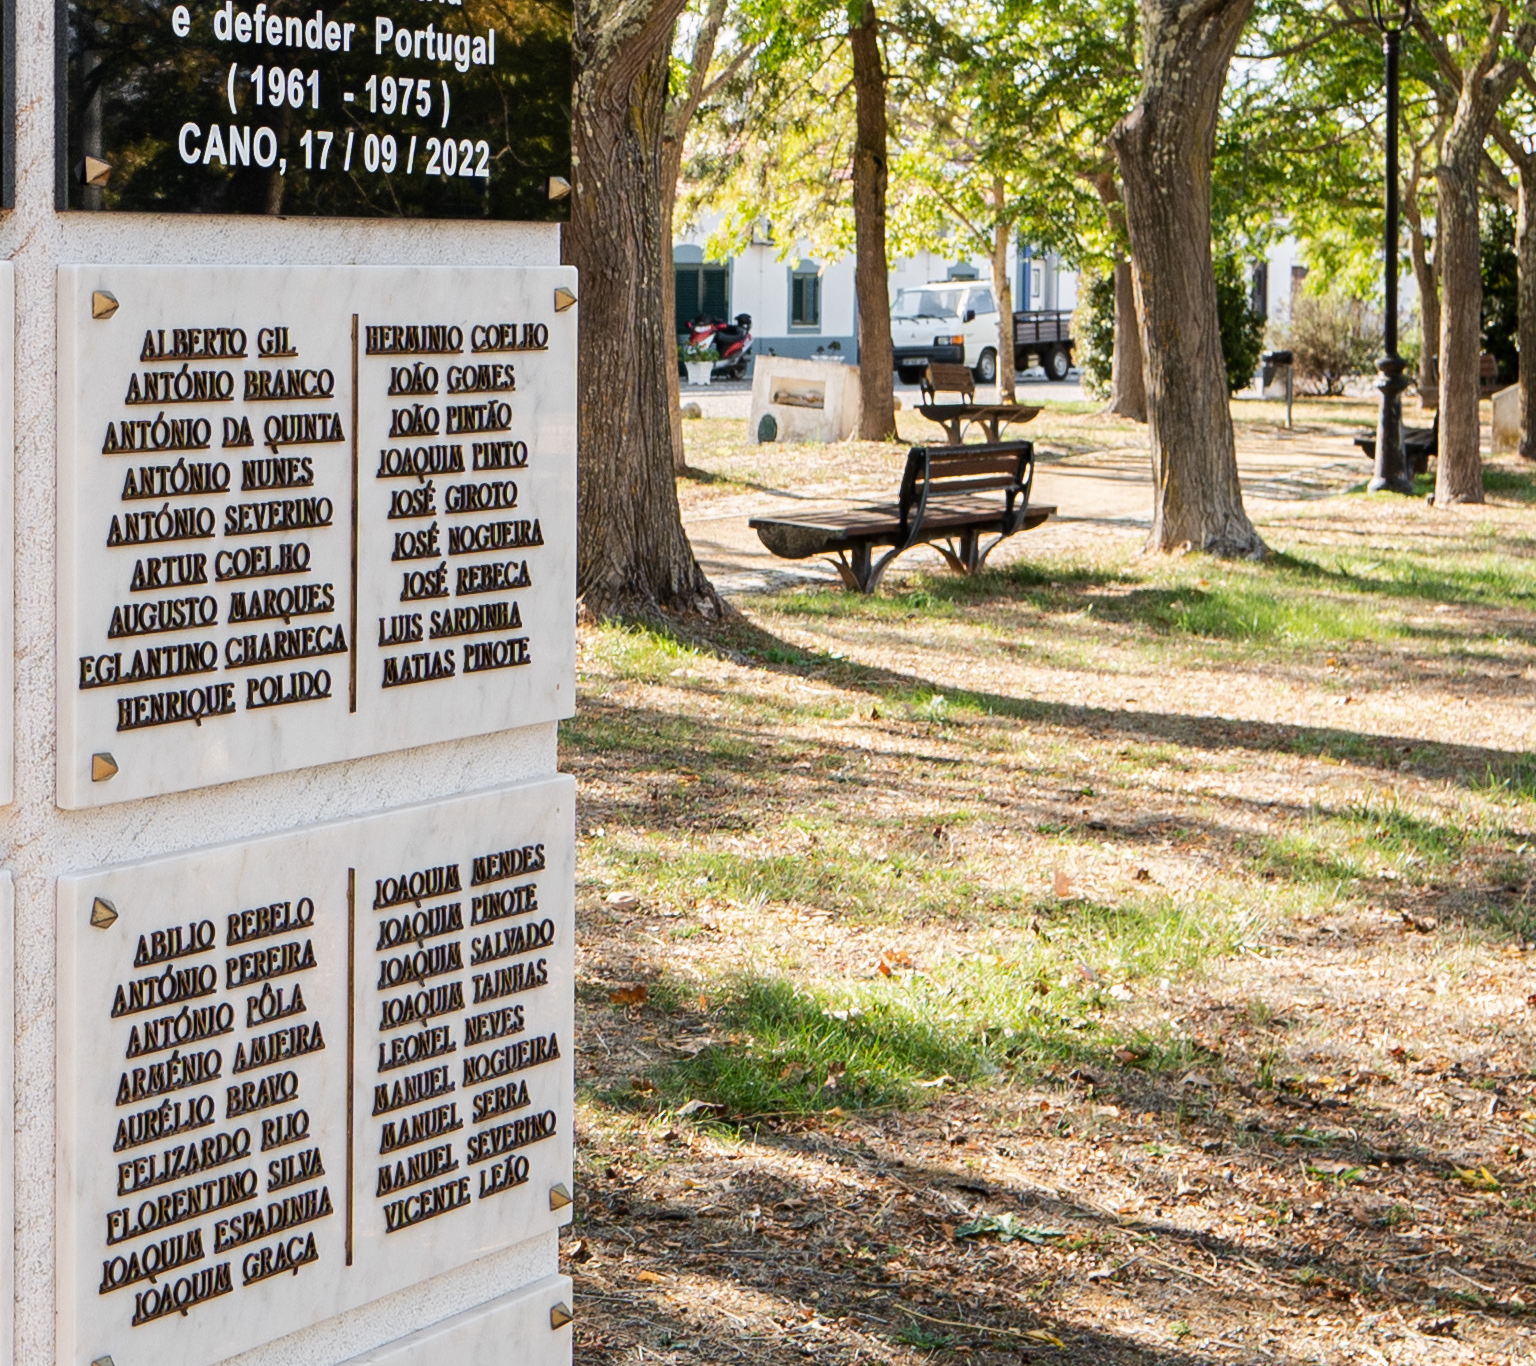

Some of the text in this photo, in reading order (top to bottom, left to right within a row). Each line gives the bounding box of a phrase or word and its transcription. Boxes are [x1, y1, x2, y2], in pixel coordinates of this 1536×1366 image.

[172, 1, 494, 72] e defender Portugal
[179, 123, 286, 175] CANO,
[140, 327, 298, 362] ALBERTO GIL
[125, 363, 334, 405] ANTÓNIO BRANCO
[388, 362, 515, 396] JOÃO GOMES
[389, 400, 512, 438] JOÃO PINTÃO
[108, 583, 334, 639] AUGUSTO MARQUES
[382, 637, 531, 689] MATIAS PINOTE
[116, 669, 331, 732] HENRIQUE POLIDO
[373, 844, 545, 910] JOAQUIM MENDES
[134, 898, 314, 968] ABILIO REBELO
[126, 982, 306, 1059] ANTÓNIO PÔLA
[372, 1033, 560, 1116] MANUEL NOGUEIRA
[379, 1080, 531, 1155] MANUEL SERRA
[107, 1147, 325, 1246] FLORENTINO SILVA
[383, 1155, 529, 1234] VICENTE LEÃO
